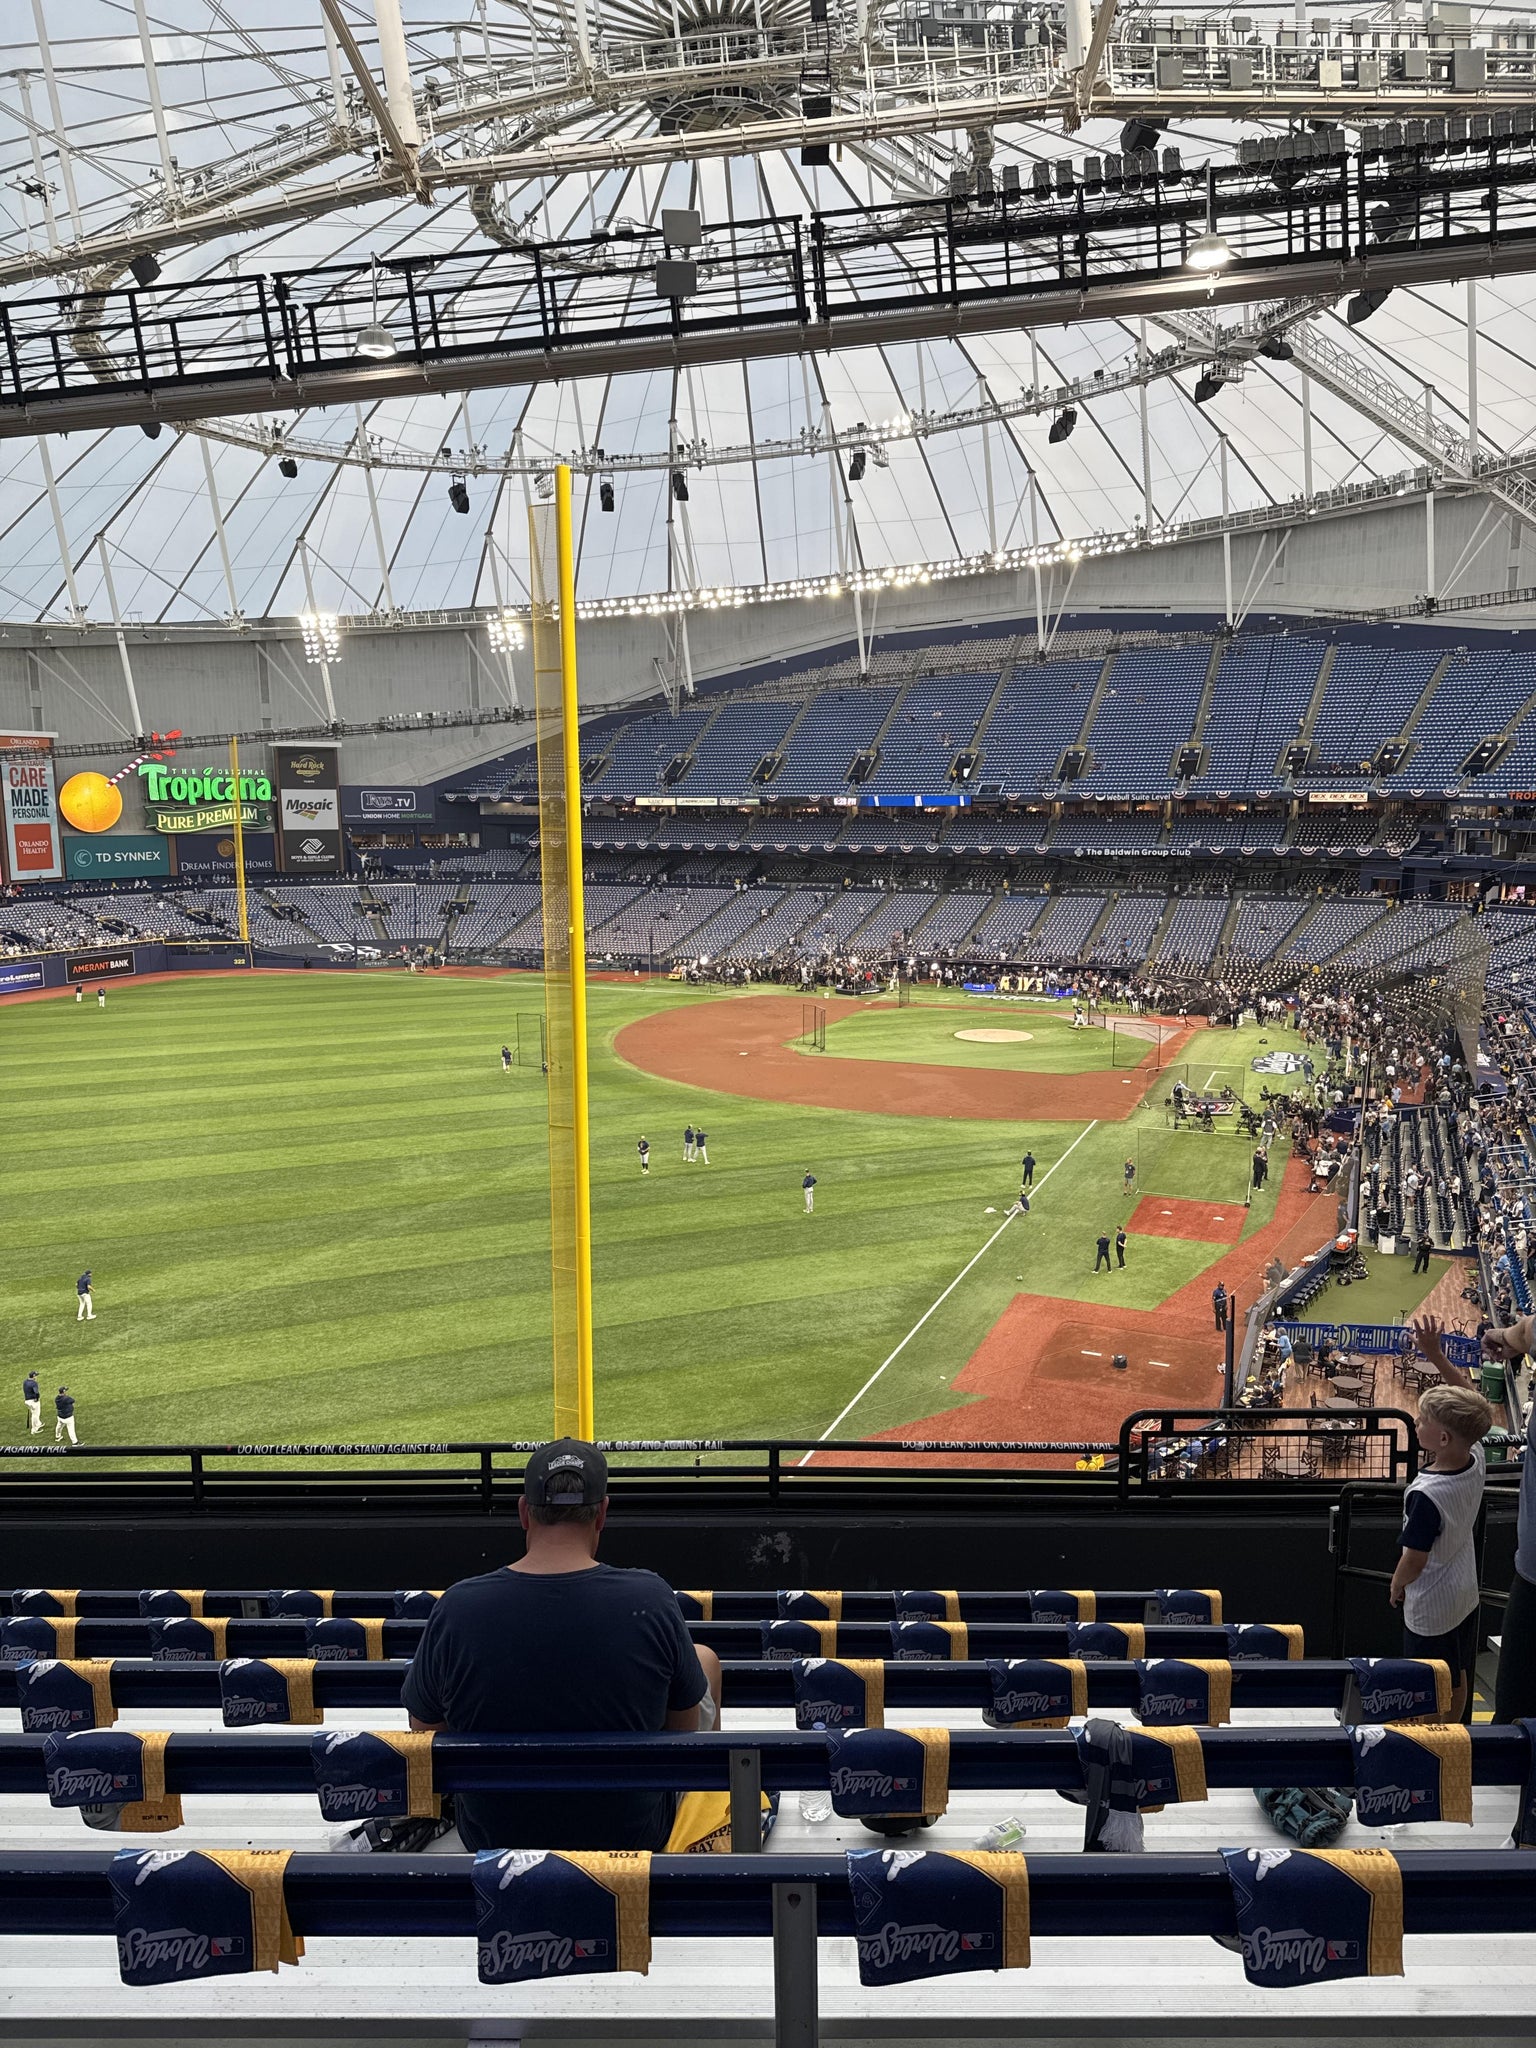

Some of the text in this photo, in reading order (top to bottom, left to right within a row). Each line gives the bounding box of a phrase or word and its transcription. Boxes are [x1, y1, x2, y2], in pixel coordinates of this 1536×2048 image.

[291, 761, 325, 770] Hard Rock
[9, 767, 48, 788] CARE
[138, 764, 272, 806] Tropicana
[11, 789, 50, 807] MADE
[286, 799, 333, 811] Mosaic
[12, 808, 51, 819] PERSONAL
[156, 807, 259, 829] PURE PREMIUM
[18, 840, 49, 848] ORLANDO
[22, 847, 48, 855] HEALTH
[1104, 848, 1140, 856] Baldwin
[1141, 849, 1169, 858] Group
[96, 850, 161, 863] TD SYNNEX
[181, 860, 273, 872] DREAM FINDER HOMES
[72, 959, 129, 974] AMERANT BANK
[3, 1445, 44, 1454] AGAINST
[46, 1445, 68, 1454] RAIL
[237, 1443, 450, 1455] DO NOT LEAN, SIT ON, OR STAND AGAINST RAIL
[514, 1441, 530, 1451] DO
[630, 1440, 662, 1451] STAND
[662, 1440, 703, 1451] AGAINST
[704, 1440, 725, 1450] RAIL
[902, 1441, 916, 1449] DO
[967, 1441, 982, 1449] SIT
[1017, 1442, 1049, 1450] STAND
[1049, 1442, 1091, 1450] AGAINST
[1091, 1442, 1114, 1450] RAIL
[229, 1699, 266, 1720] World
[1012, 1694, 1050, 1714] World
[1150, 1696, 1186, 1717] World
[1378, 1691, 1414, 1710] World
[34, 1709, 72, 1731] World
[804, 1703, 843, 1723] World
[59, 1771, 113, 1799] World
[847, 1775, 893, 1797] World
[326, 1787, 378, 1813] World
[1366, 1788, 1412, 1815] World
[1353, 1849, 1385, 1857] FOR
[134, 1934, 210, 1973] World
[499, 1936, 574, 1973] World
[888, 1929, 960, 1964] World
[1262, 1936, 1327, 1975] World
